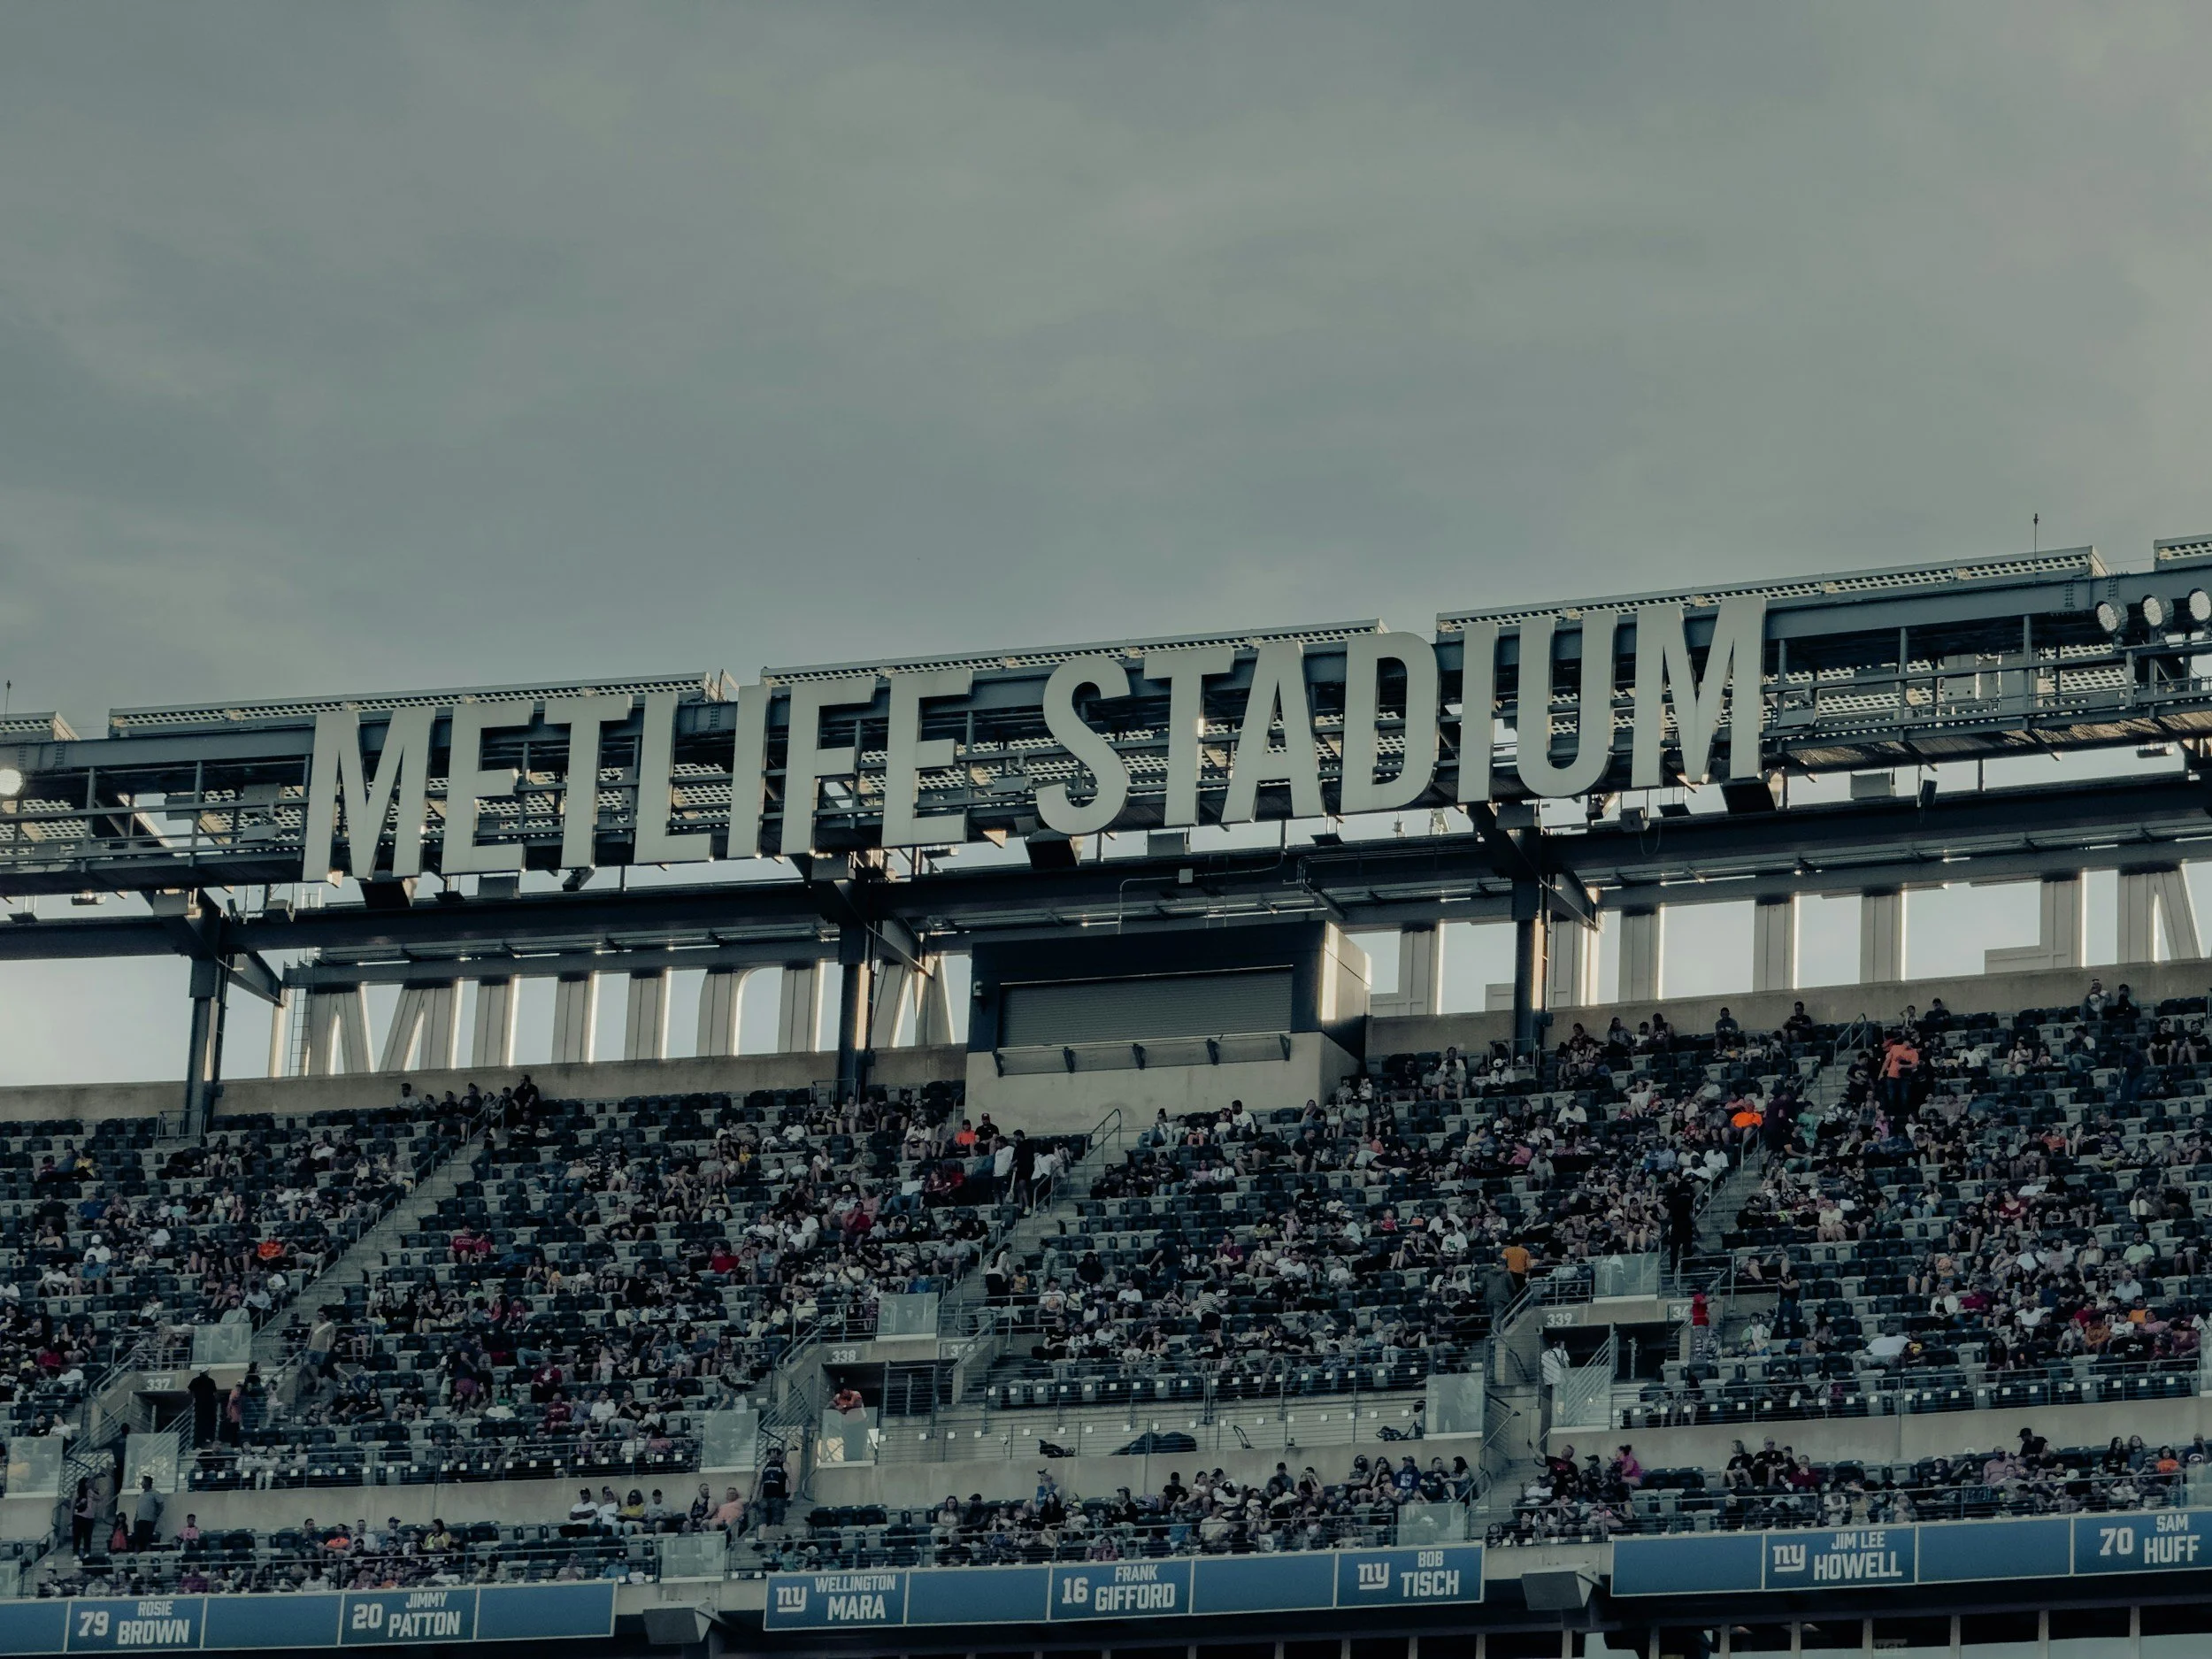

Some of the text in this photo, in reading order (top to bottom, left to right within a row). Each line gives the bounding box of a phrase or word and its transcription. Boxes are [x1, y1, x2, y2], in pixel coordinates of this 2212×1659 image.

[302, 596, 1765, 881] METLIFE STADIUM
[1547, 1312, 1573, 1326] 339
[832, 1349, 857, 1363] 338
[146, 1377, 171, 1391] 337
[2156, 1514, 2188, 1532] SAM
[1830, 1531, 1886, 1551] JIM LEE
[2100, 1527, 2133, 1555] 70
[2145, 1534, 2201, 1563] HUFF
[1417, 1550, 1444, 1569] BOB
[1814, 1550, 1902, 1581] HOWELL
[815, 1574, 896, 1594] WELLINGTON
[1115, 1564, 1158, 1583] FRANK
[1401, 1570, 1459, 1597] TISCH
[405, 1591, 448, 1609] JIMMY
[1063, 1578, 1088, 1603] 16
[1095, 1583, 1176, 1612] GIFFORD
[137, 1600, 173, 1617] ROSIE
[353, 1603, 383, 1629] 20
[828, 1594, 887, 1621] MARA
[79, 1610, 109, 1637] 79
[117, 1618, 190, 1646] BROWN
[388, 1610, 461, 1638] PATTON
